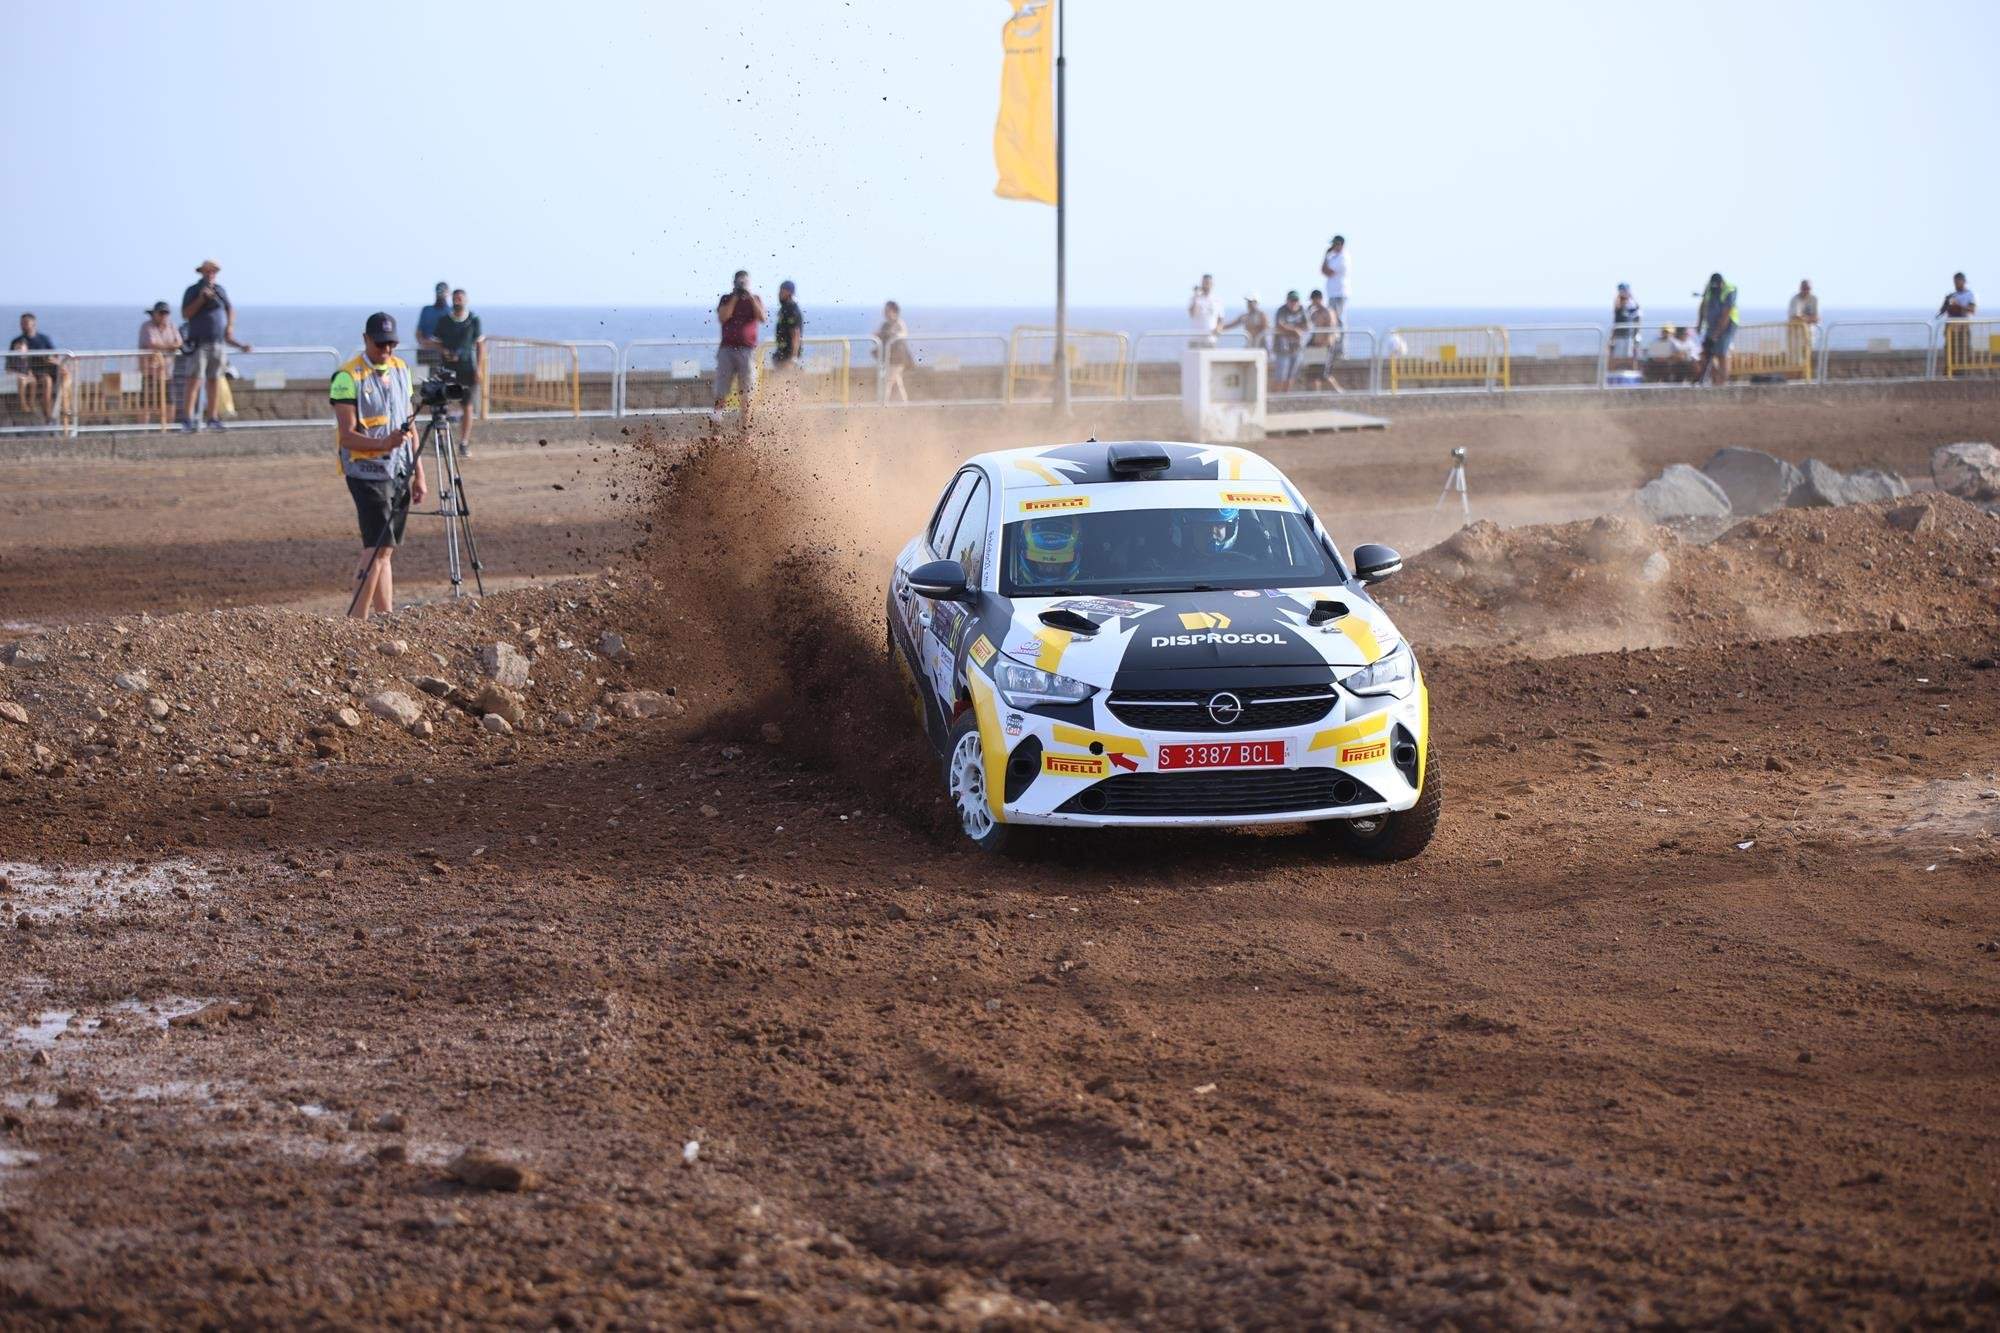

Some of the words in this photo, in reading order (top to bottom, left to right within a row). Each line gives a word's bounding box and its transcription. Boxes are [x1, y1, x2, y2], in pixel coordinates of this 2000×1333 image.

[1025, 498, 1083, 510] PIRELLI
[1226, 493, 1282, 503] PIRELLI
[1151, 632, 1287, 648] DISPROSOL
[1160, 748, 1170, 765] S
[1185, 746, 1231, 765] 3387
[1240, 744, 1274, 763] BCL
[1342, 742, 1386, 763] PIRELLI
[1046, 756, 1102, 774] PIRELLI
